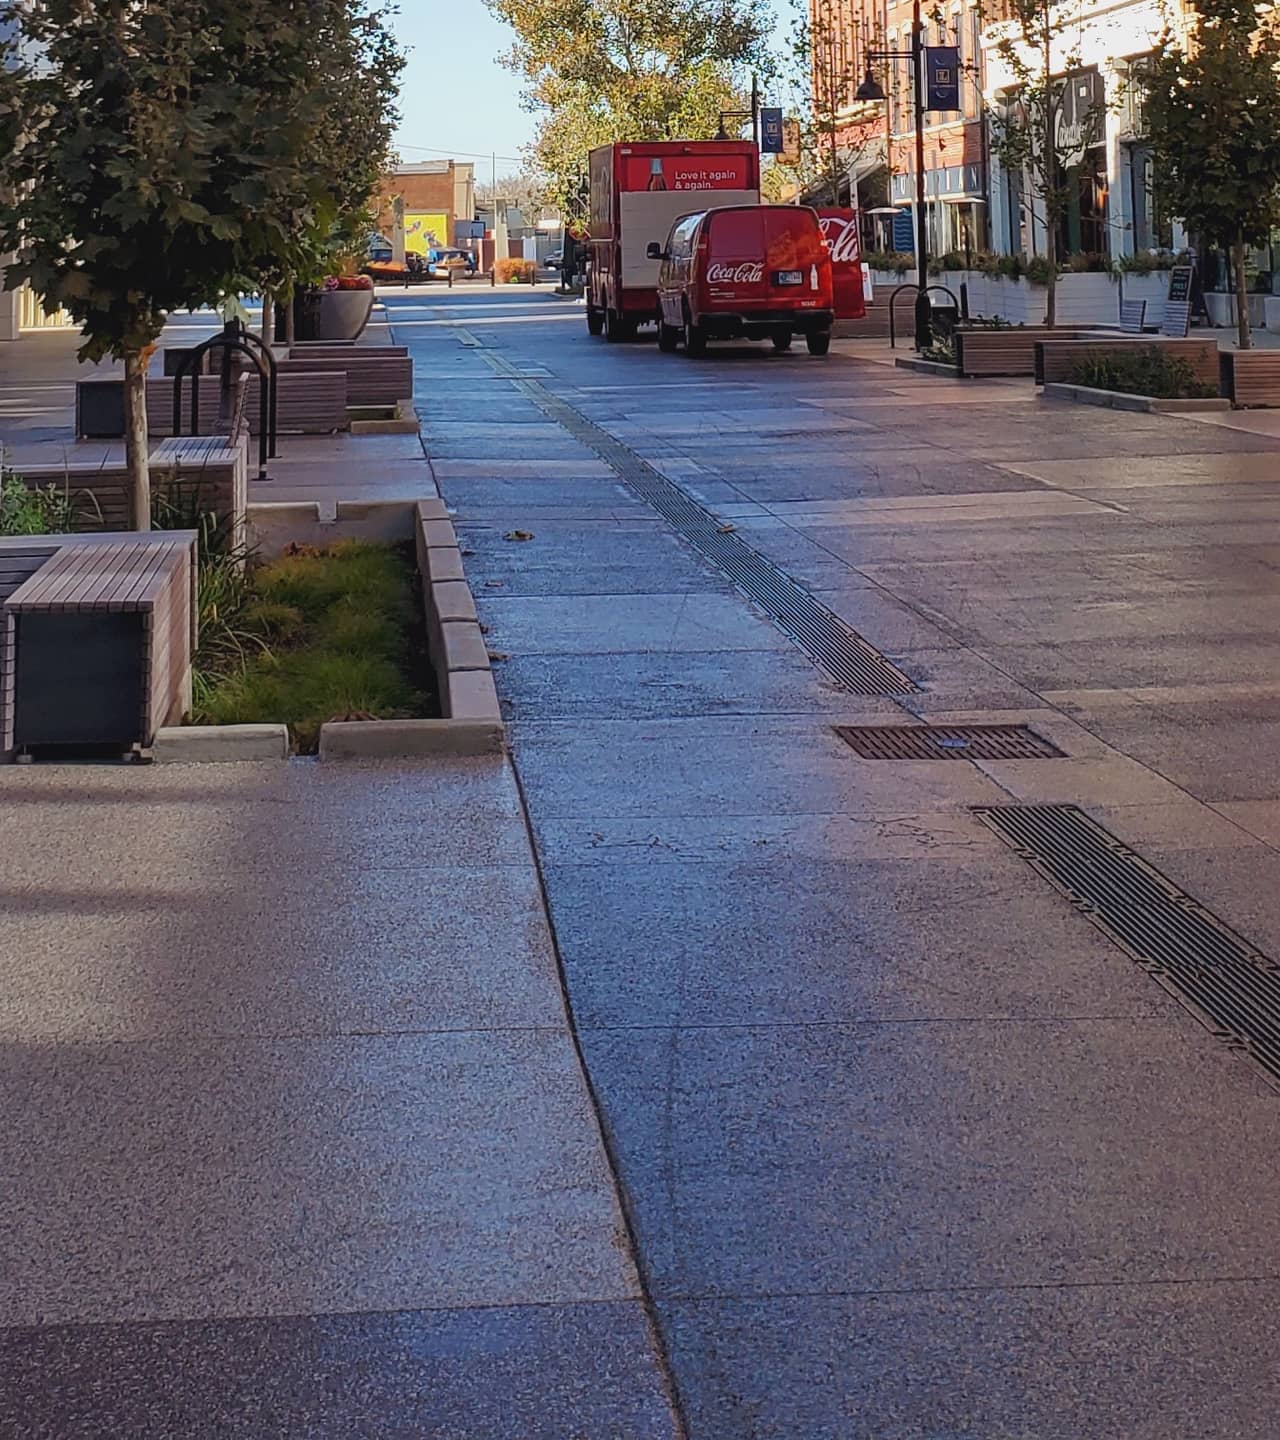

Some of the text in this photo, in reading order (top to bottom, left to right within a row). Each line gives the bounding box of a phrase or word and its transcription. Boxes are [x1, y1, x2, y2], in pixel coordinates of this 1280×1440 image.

[675, 170, 736, 181] Love it again
[675, 180, 682, 189] &
[706, 262, 765, 284] Coca-Cola
